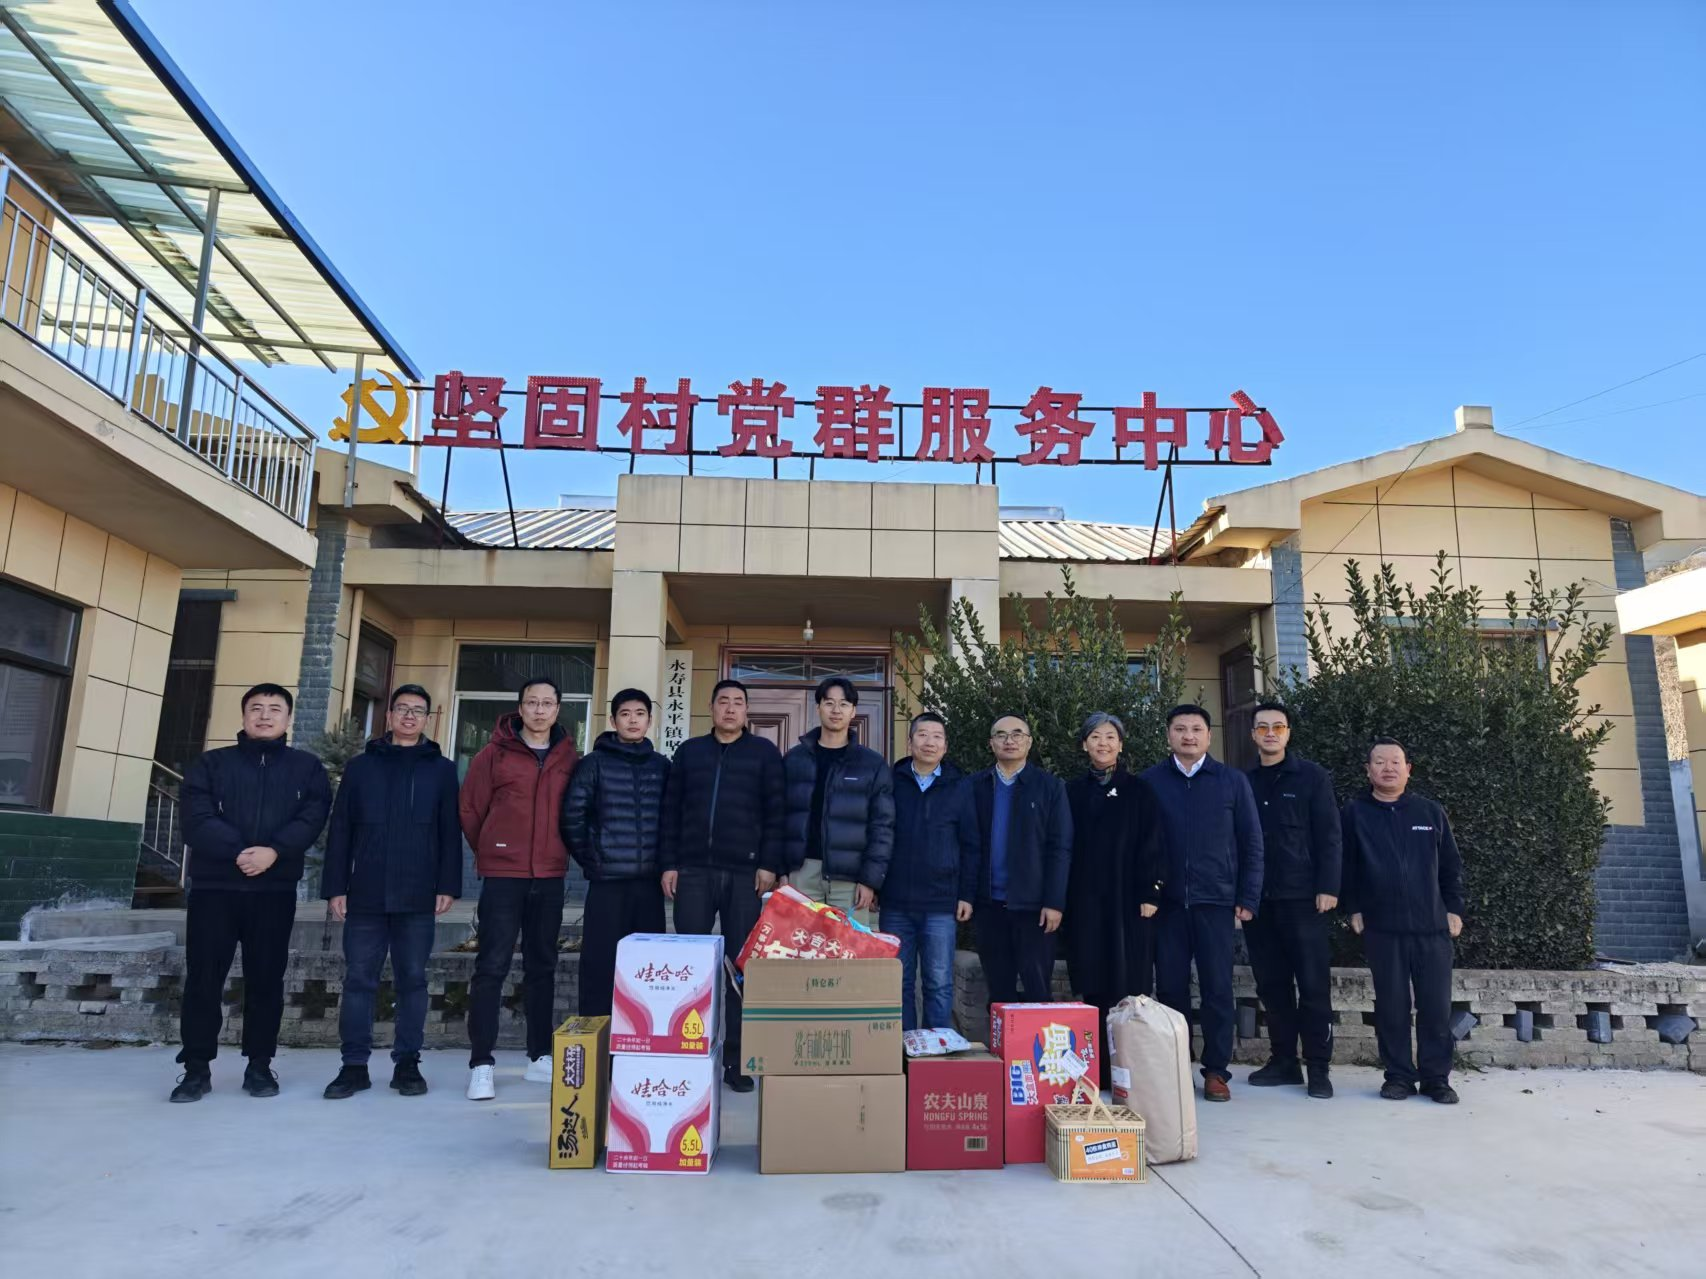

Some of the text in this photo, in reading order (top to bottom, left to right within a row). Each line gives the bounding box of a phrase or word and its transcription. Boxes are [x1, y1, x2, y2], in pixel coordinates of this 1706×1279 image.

[423, 370, 1285, 470] 坚固村党群服务中心
[634, 962, 693, 982] 娃哈哈
[684, 1023, 702, 1035] 5.5L
[631, 1078, 690, 1098] 娃哈哈
[1010, 1065, 1026, 1104] BIG
[923, 1092, 988, 1110] 农夫山泉
[923, 1112, 988, 1121] NONGFU SPRING
[682, 1139, 700, 1152] 5.5L
